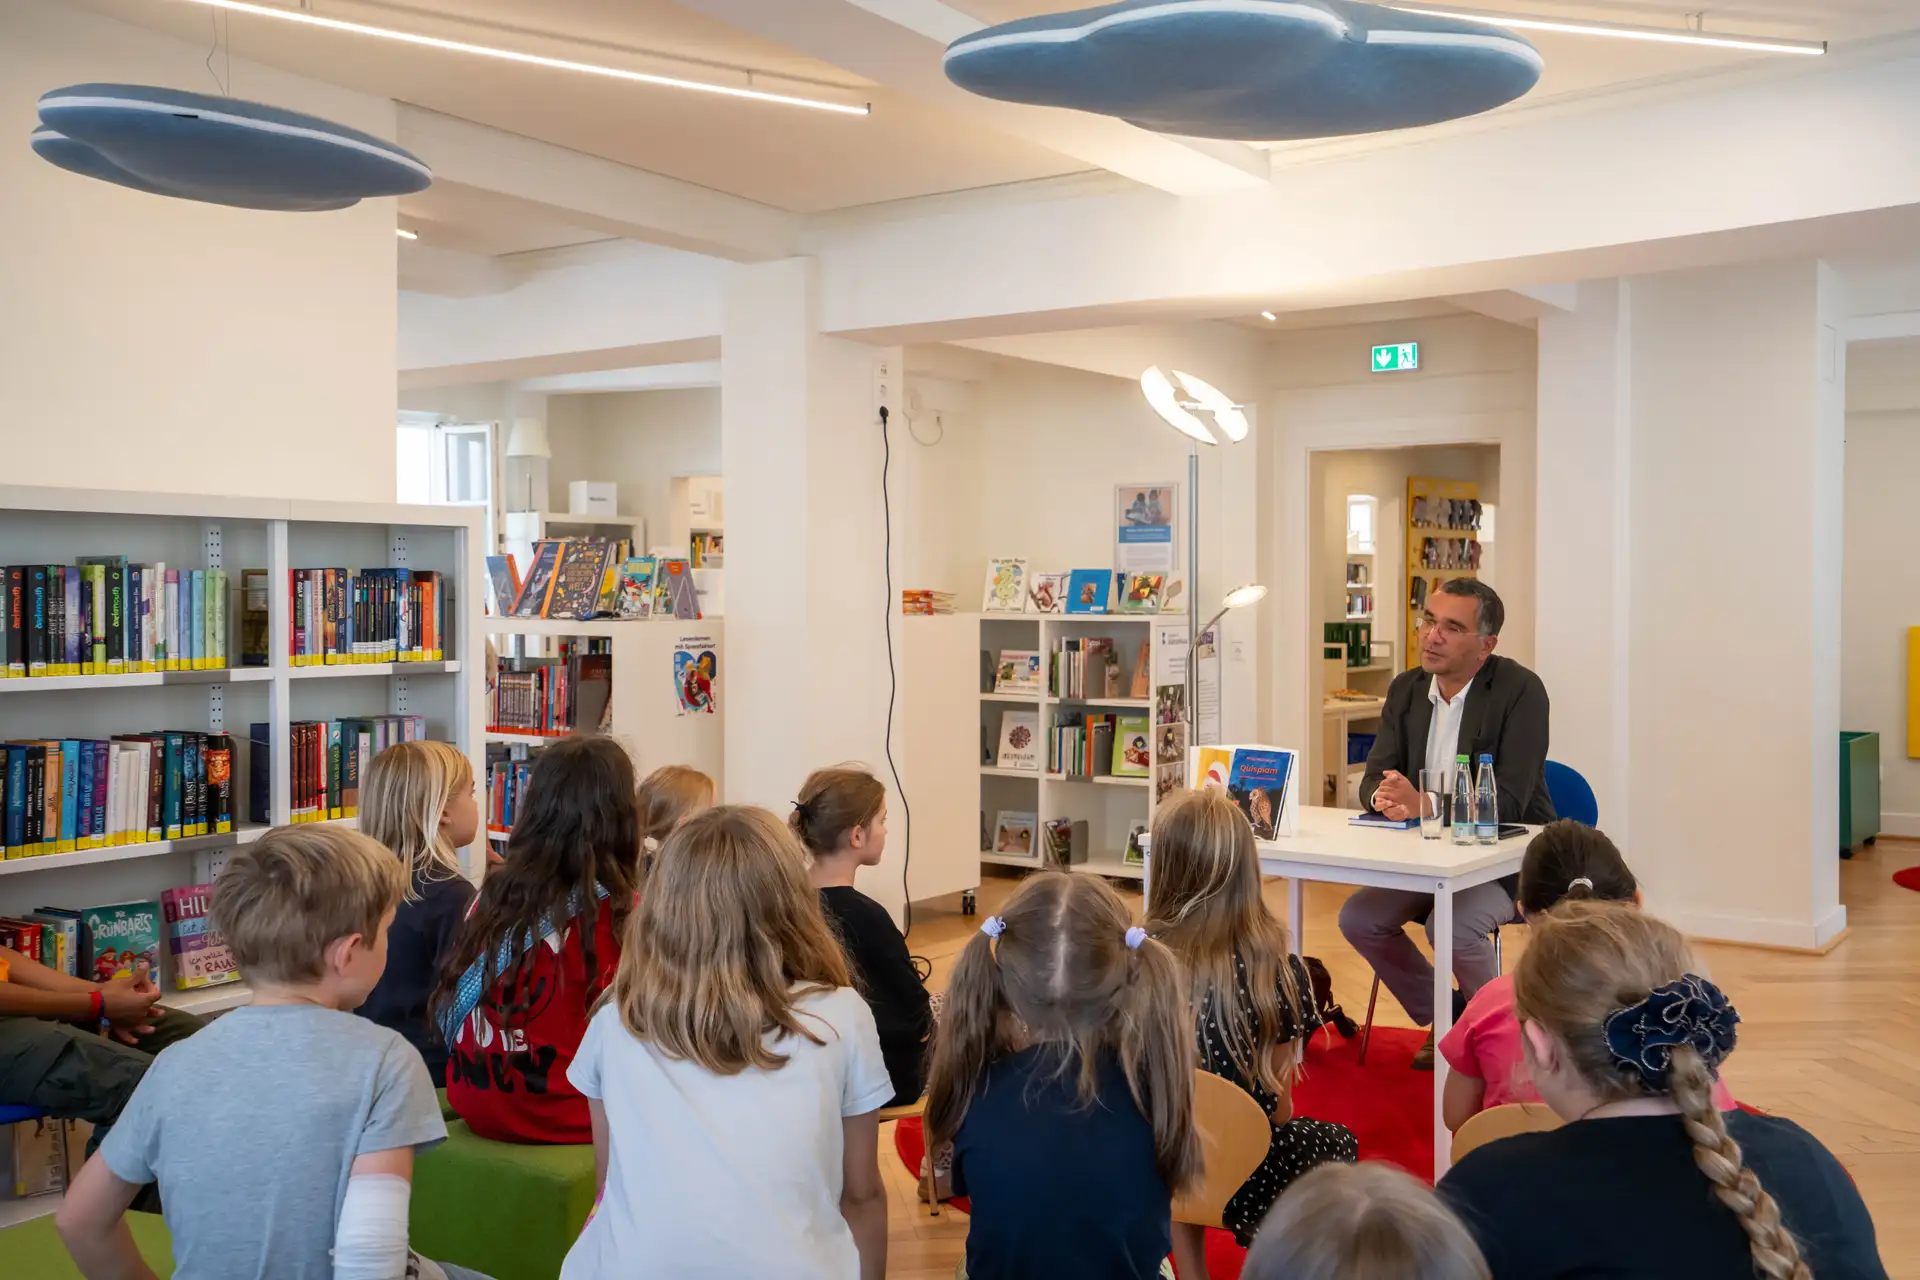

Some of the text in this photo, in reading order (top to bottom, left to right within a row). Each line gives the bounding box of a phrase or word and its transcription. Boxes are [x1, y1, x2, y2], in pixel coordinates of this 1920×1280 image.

[1240, 764, 1278, 775] Quispiam
[179, 895, 209, 917] HIL
[88, 913, 153, 940] GRÜNBARTS
